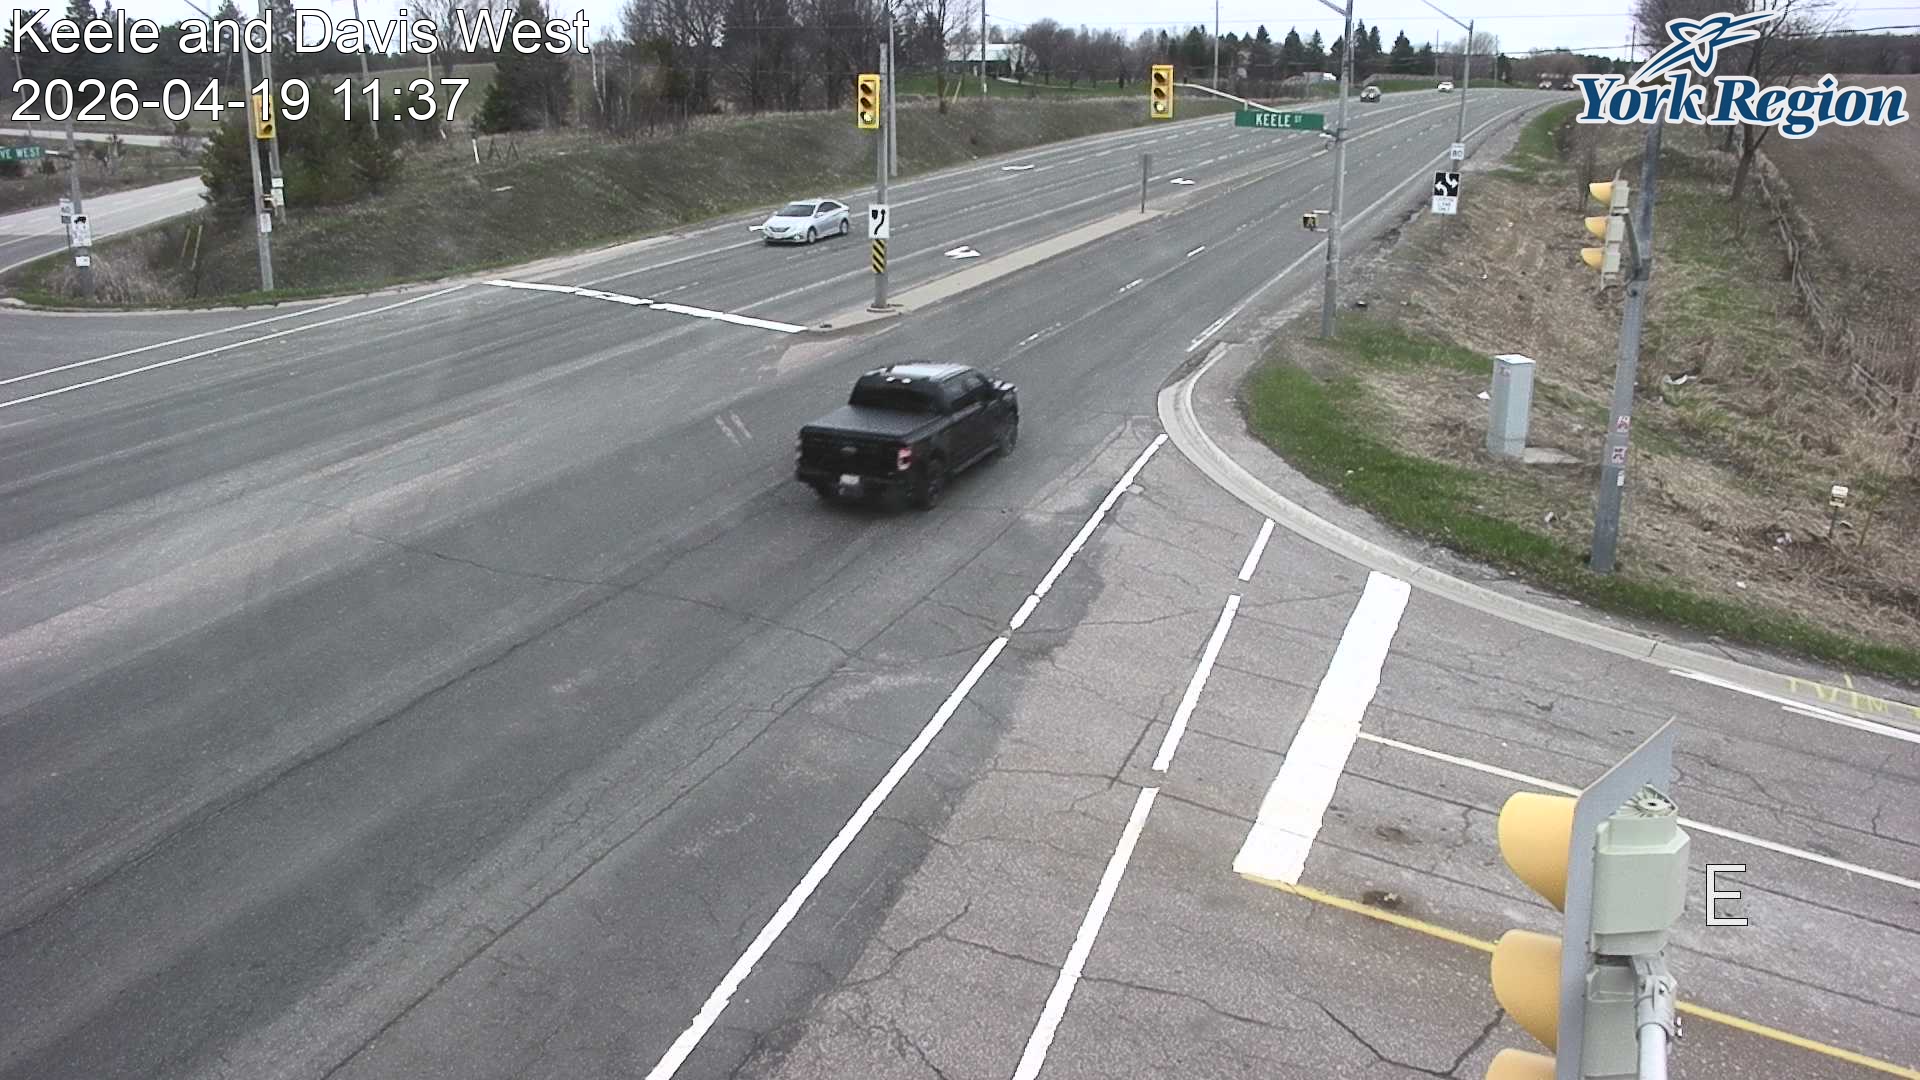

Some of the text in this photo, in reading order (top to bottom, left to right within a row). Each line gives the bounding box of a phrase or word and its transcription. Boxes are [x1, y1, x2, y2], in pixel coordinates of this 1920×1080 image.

[1256, 113, 1302, 127] KEELE ST
[0, 147, 40, 159] VE WEST
